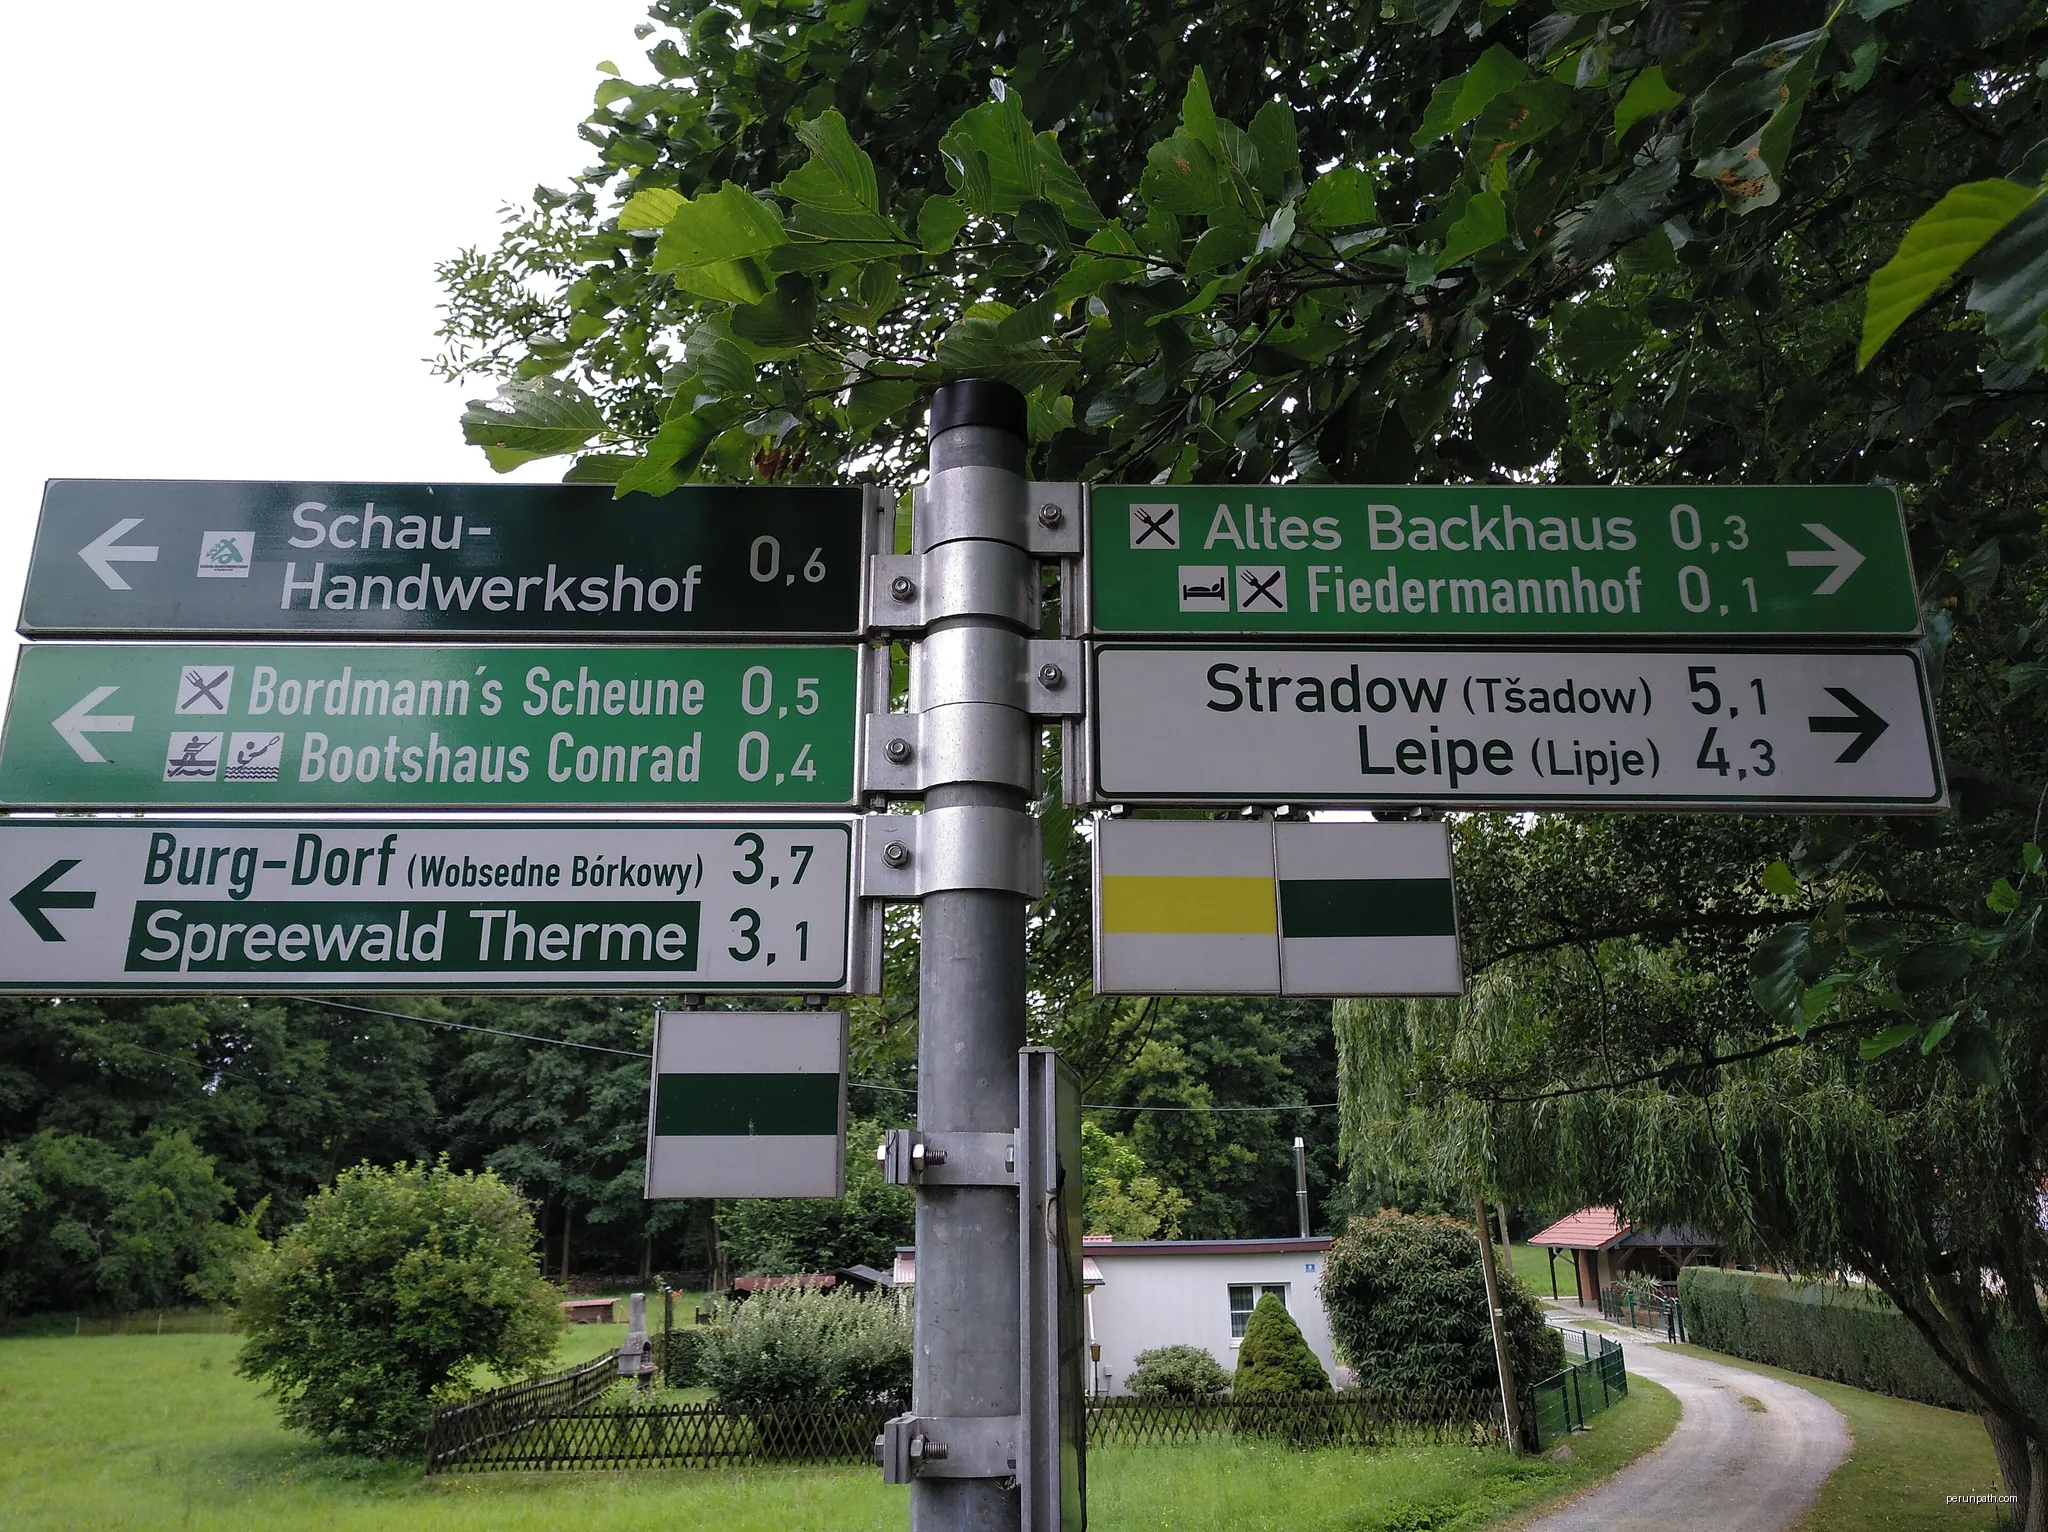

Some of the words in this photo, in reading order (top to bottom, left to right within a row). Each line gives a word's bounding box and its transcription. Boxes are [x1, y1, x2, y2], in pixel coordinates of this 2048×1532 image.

[288, 502, 491, 549] Schau-
[1204, 504, 1341, 550] Altes
[1368, 505, 1636, 550] Backhaus
[1670, 504, 1749, 554] 0,3
[750, 536, 825, 586] 0,6
[280, 563, 702, 613] Handwerkshof
[1308, 566, 1641, 613] Fiedermannhof
[1678, 566, 1757, 616] 0,1
[523, 666, 704, 715] Scheune
[742, 666, 818, 719] 0,5
[1207, 663, 1447, 713] Stradow
[1464, 676, 1651, 716] (Tšadow)
[1688, 666, 1766, 719] 5,1
[299, 732, 529, 782] Bootshaus
[548, 732, 701, 782] Conrad
[738, 731, 816, 786] 0,4
[1359, 725, 1513, 789] Leipe
[1532, 738, 1659, 785] (Lipje)
[1697, 727, 1775, 781] 4,3
[408, 854, 560, 889] (Wobsedne
[572, 854, 702, 895] Bórkowy)
[733, 833, 813, 889] 3,7
[140, 908, 444, 973] Spreewald
[470, 909, 686, 960] Therme
[729, 908, 807, 966] 3,1
